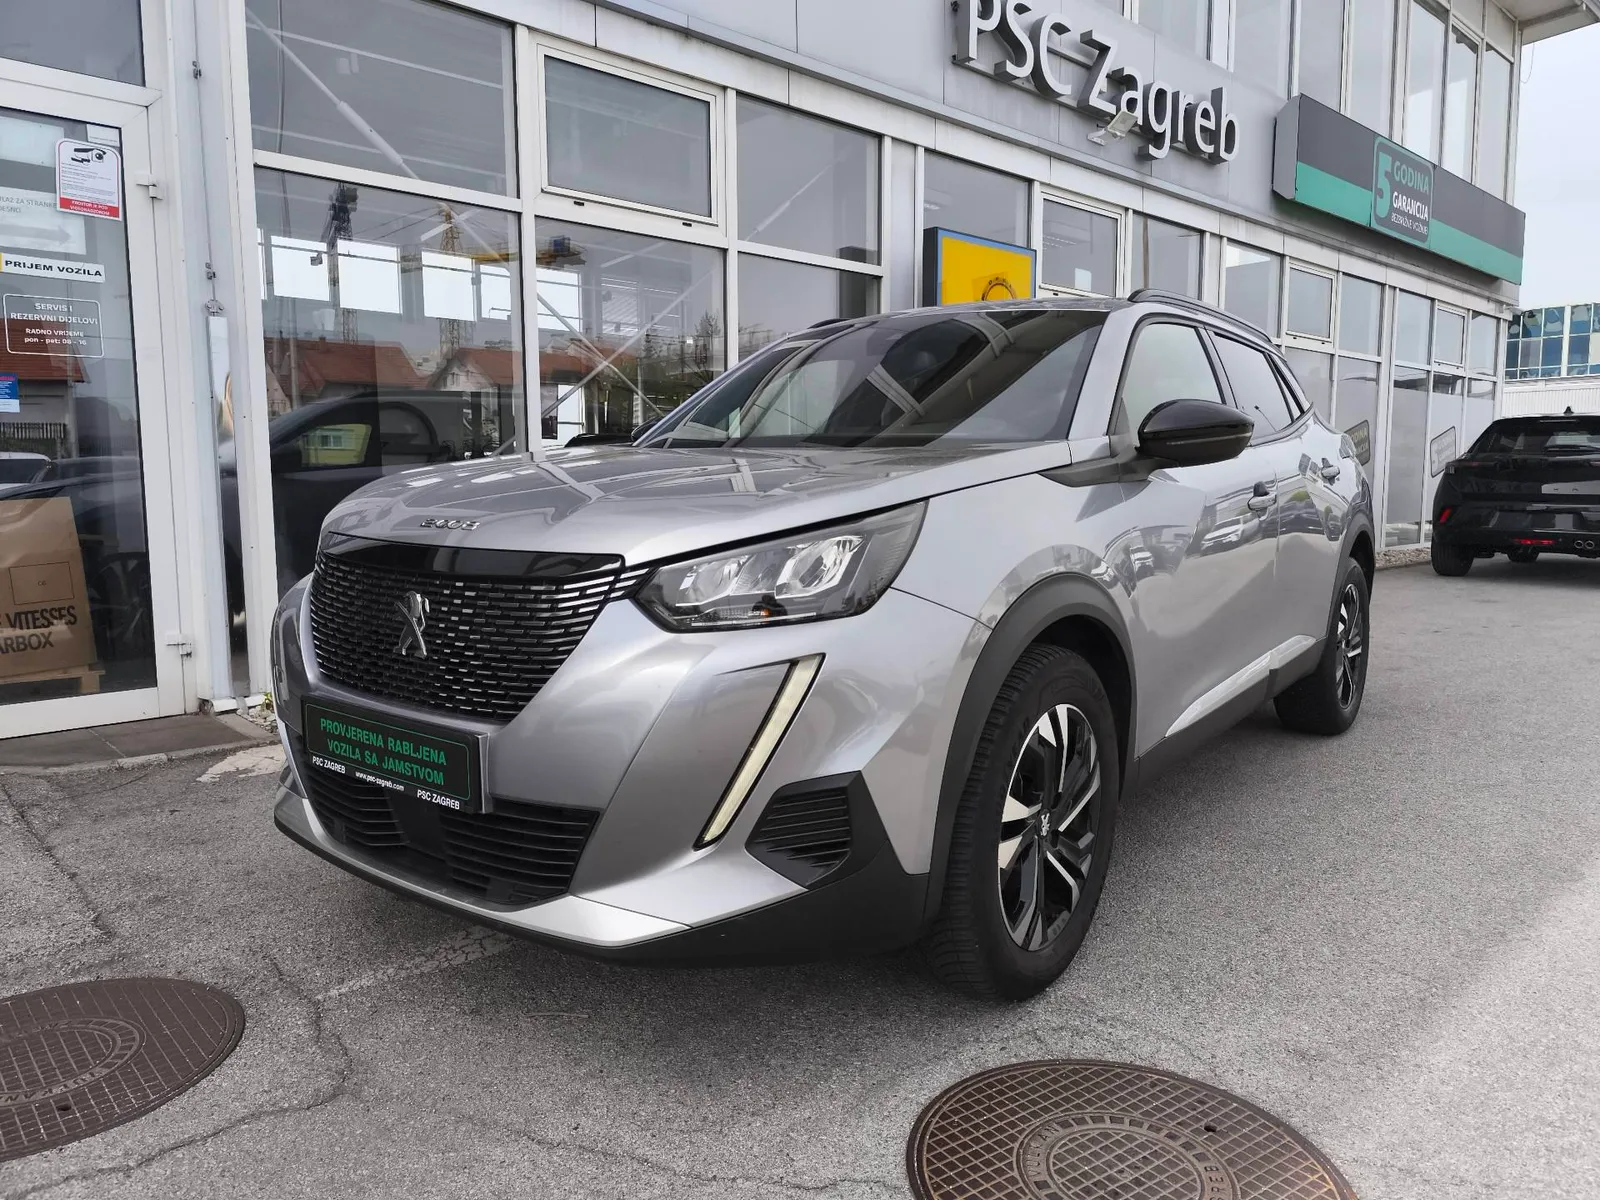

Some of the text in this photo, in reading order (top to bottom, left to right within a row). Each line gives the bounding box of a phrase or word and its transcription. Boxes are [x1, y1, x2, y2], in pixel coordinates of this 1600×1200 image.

[957, 0, 1241, 163] PSC Zagreb
[1376, 152, 1392, 218] 5
[1394, 161, 1429, 194] GODINA
[1392, 191, 1429, 221] GARANCIJA
[5, 260, 103, 277] PRIJEM VOZILA
[34, 302, 67, 312] SERVIS
[10, 312, 98, 325] REZERVNI DIJELOVI
[24, 336, 39, 344] pon
[45, 337, 61, 345] pet:
[25, 328, 84, 337] RADNO VRIJEME
[5, 605, 77, 630] VITESSES
[320, 717, 447, 766] PROVJERENA RABLJENA
[312, 755, 346, 775] PSC ZAGREB
[327, 738, 445, 786] VOZILA SA JAMSTVOM
[355, 770, 405, 792] www.psc-zagreb.com
[417, 788, 460, 810] PSC ZAGREB
